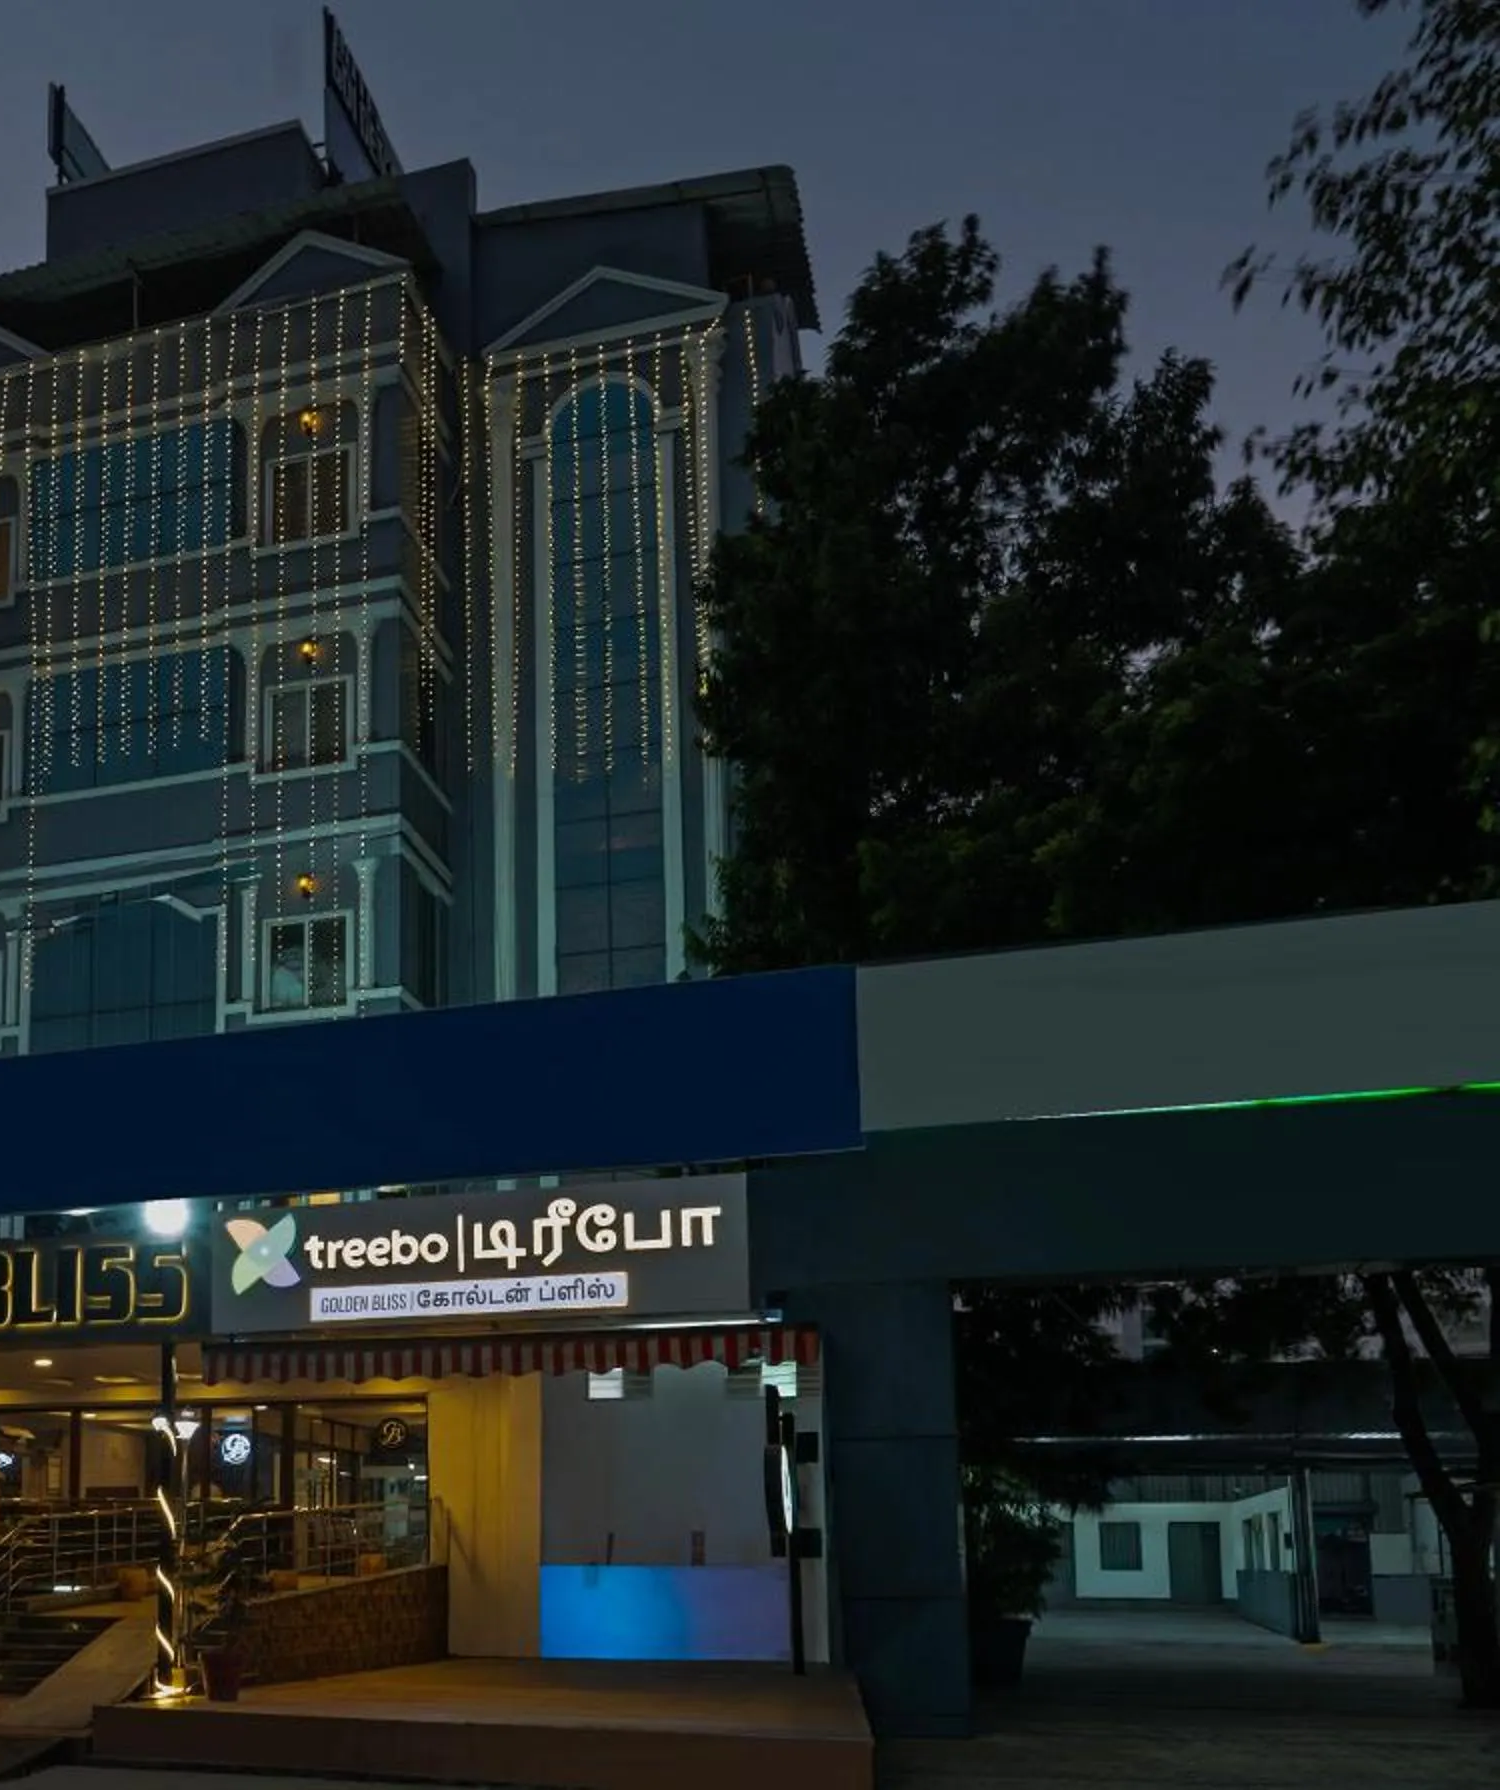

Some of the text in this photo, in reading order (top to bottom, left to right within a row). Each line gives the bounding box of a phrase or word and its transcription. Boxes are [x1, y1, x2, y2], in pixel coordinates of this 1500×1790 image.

[304, 1230, 449, 1270] treebo
[473, 1198, 721, 1270] டிரீபோ
[320, 1293, 408, 1314] GOLDEN BLISS
[416, 1279, 531, 1309] கோல்டன்
